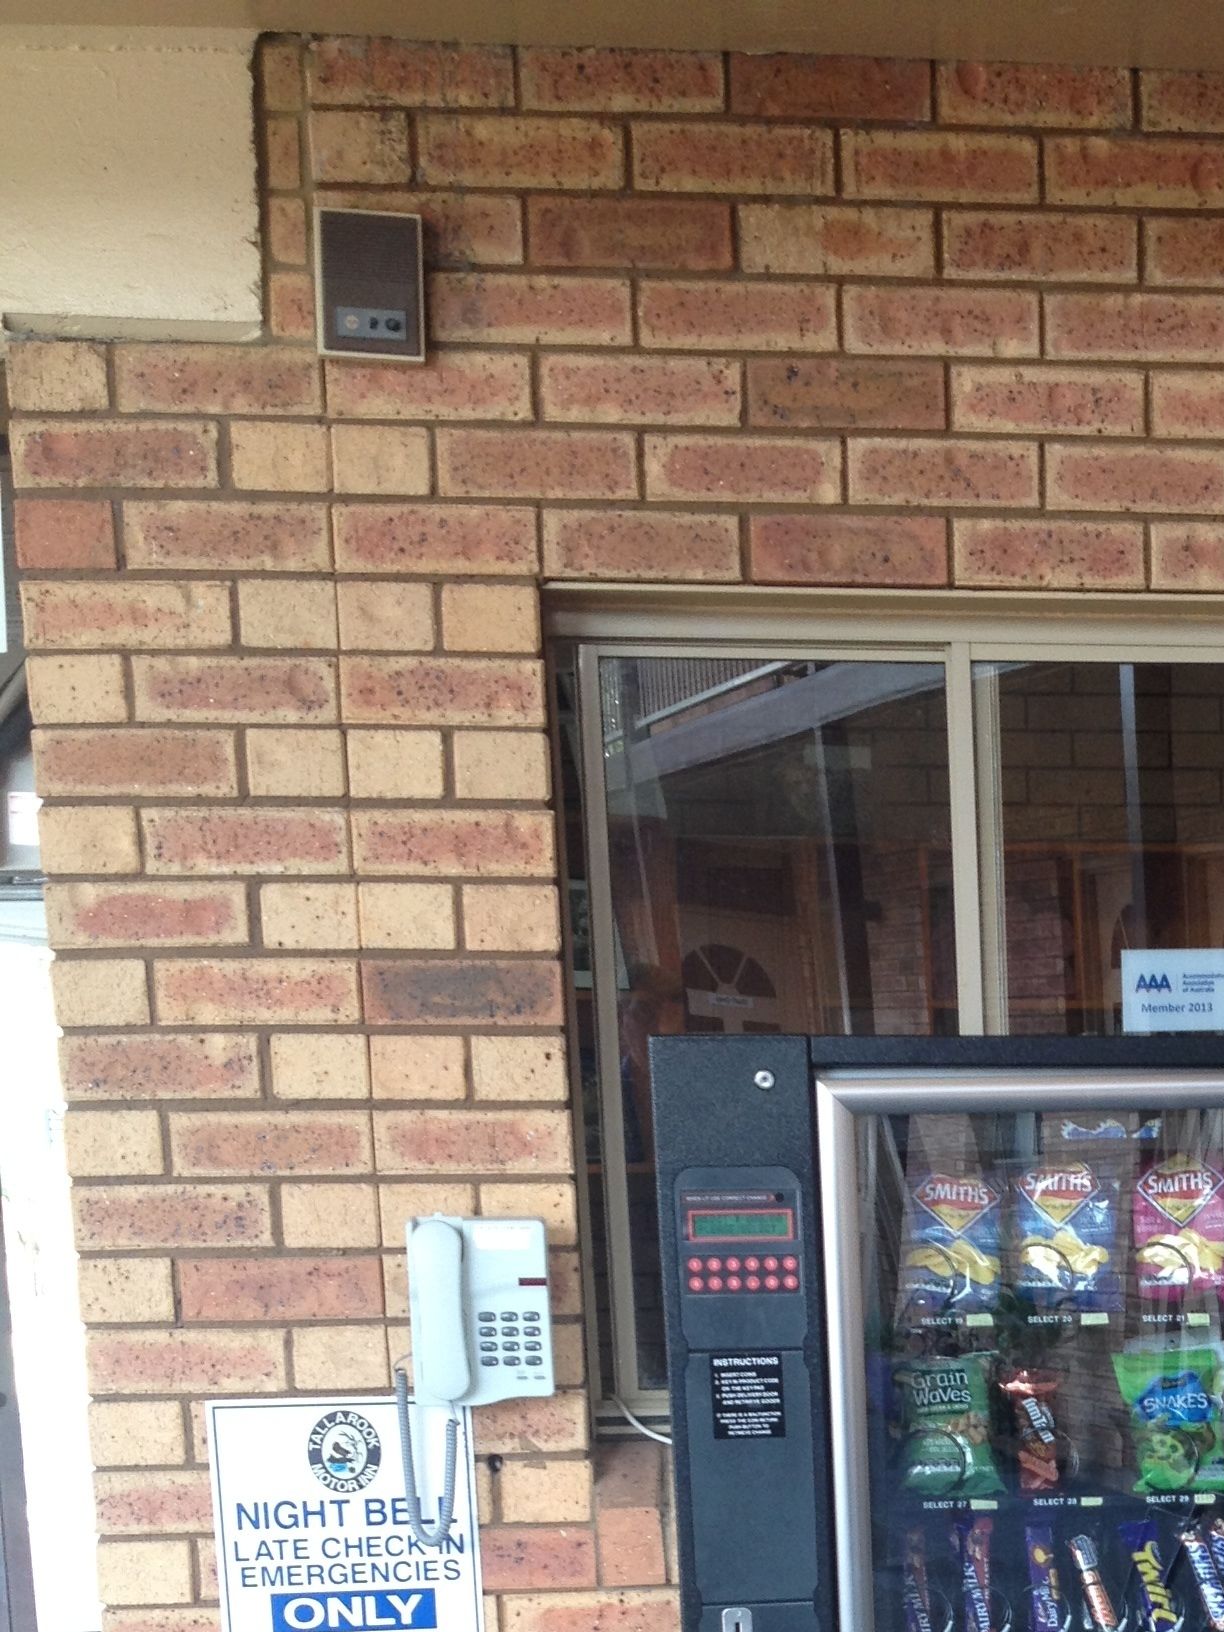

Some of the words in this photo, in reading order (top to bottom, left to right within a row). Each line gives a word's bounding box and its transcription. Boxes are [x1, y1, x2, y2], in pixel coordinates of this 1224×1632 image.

[1135, 973, 1172, 993] AAA
[1141, 1003, 1185, 1013] Member
[1188, 1003, 1213, 1013] 2013
[921, 1317, 952, 1326] SELECT
[1027, 1315, 1060, 1324] SELECT
[1142, 1314, 1173, 1323] SELECT
[713, 1356, 779, 1367] INSTRUCTIONS
[911, 1370, 969, 1388] Grain
[1143, 1394, 1209, 1414] SNAKES
[309, 1411, 380, 1451] TALLAROOK
[311, 1463, 360, 1492] MOTOR
[357, 1463, 379, 1487] INN
[923, 1500, 954, 1509] SELECT
[1033, 1498, 1065, 1506] SELECT
[1146, 1495, 1176, 1504] SELECT
[236, 1500, 350, 1531] NIGHT
[233, 1538, 310, 1562] LATE
[321, 1534, 426, 1559] CHECK
[241, 1559, 461, 1588] EMERGENCIES
[283, 1594, 423, 1630] ONLY
